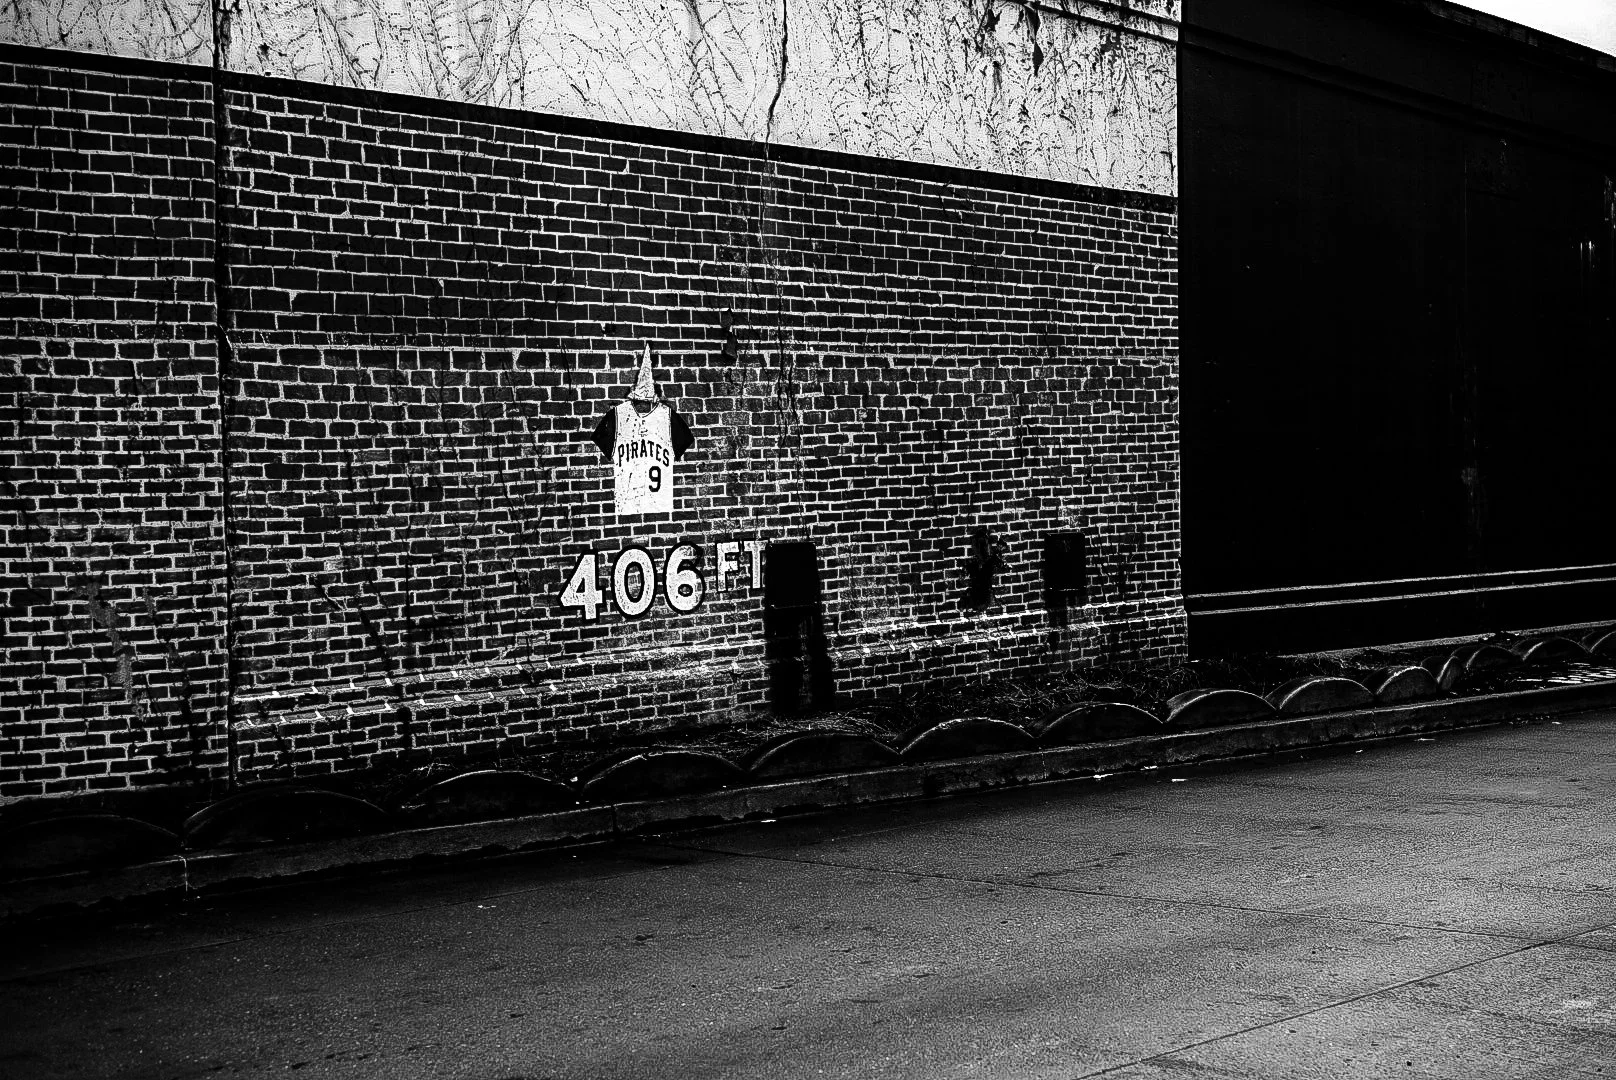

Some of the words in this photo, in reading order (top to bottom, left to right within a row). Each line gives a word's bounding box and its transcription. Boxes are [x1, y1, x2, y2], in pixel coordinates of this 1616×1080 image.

[617, 439, 670, 467] PIRATES
[648, 465, 662, 493] 9
[559, 541, 705, 622] 406
[716, 540, 769, 592] FT
